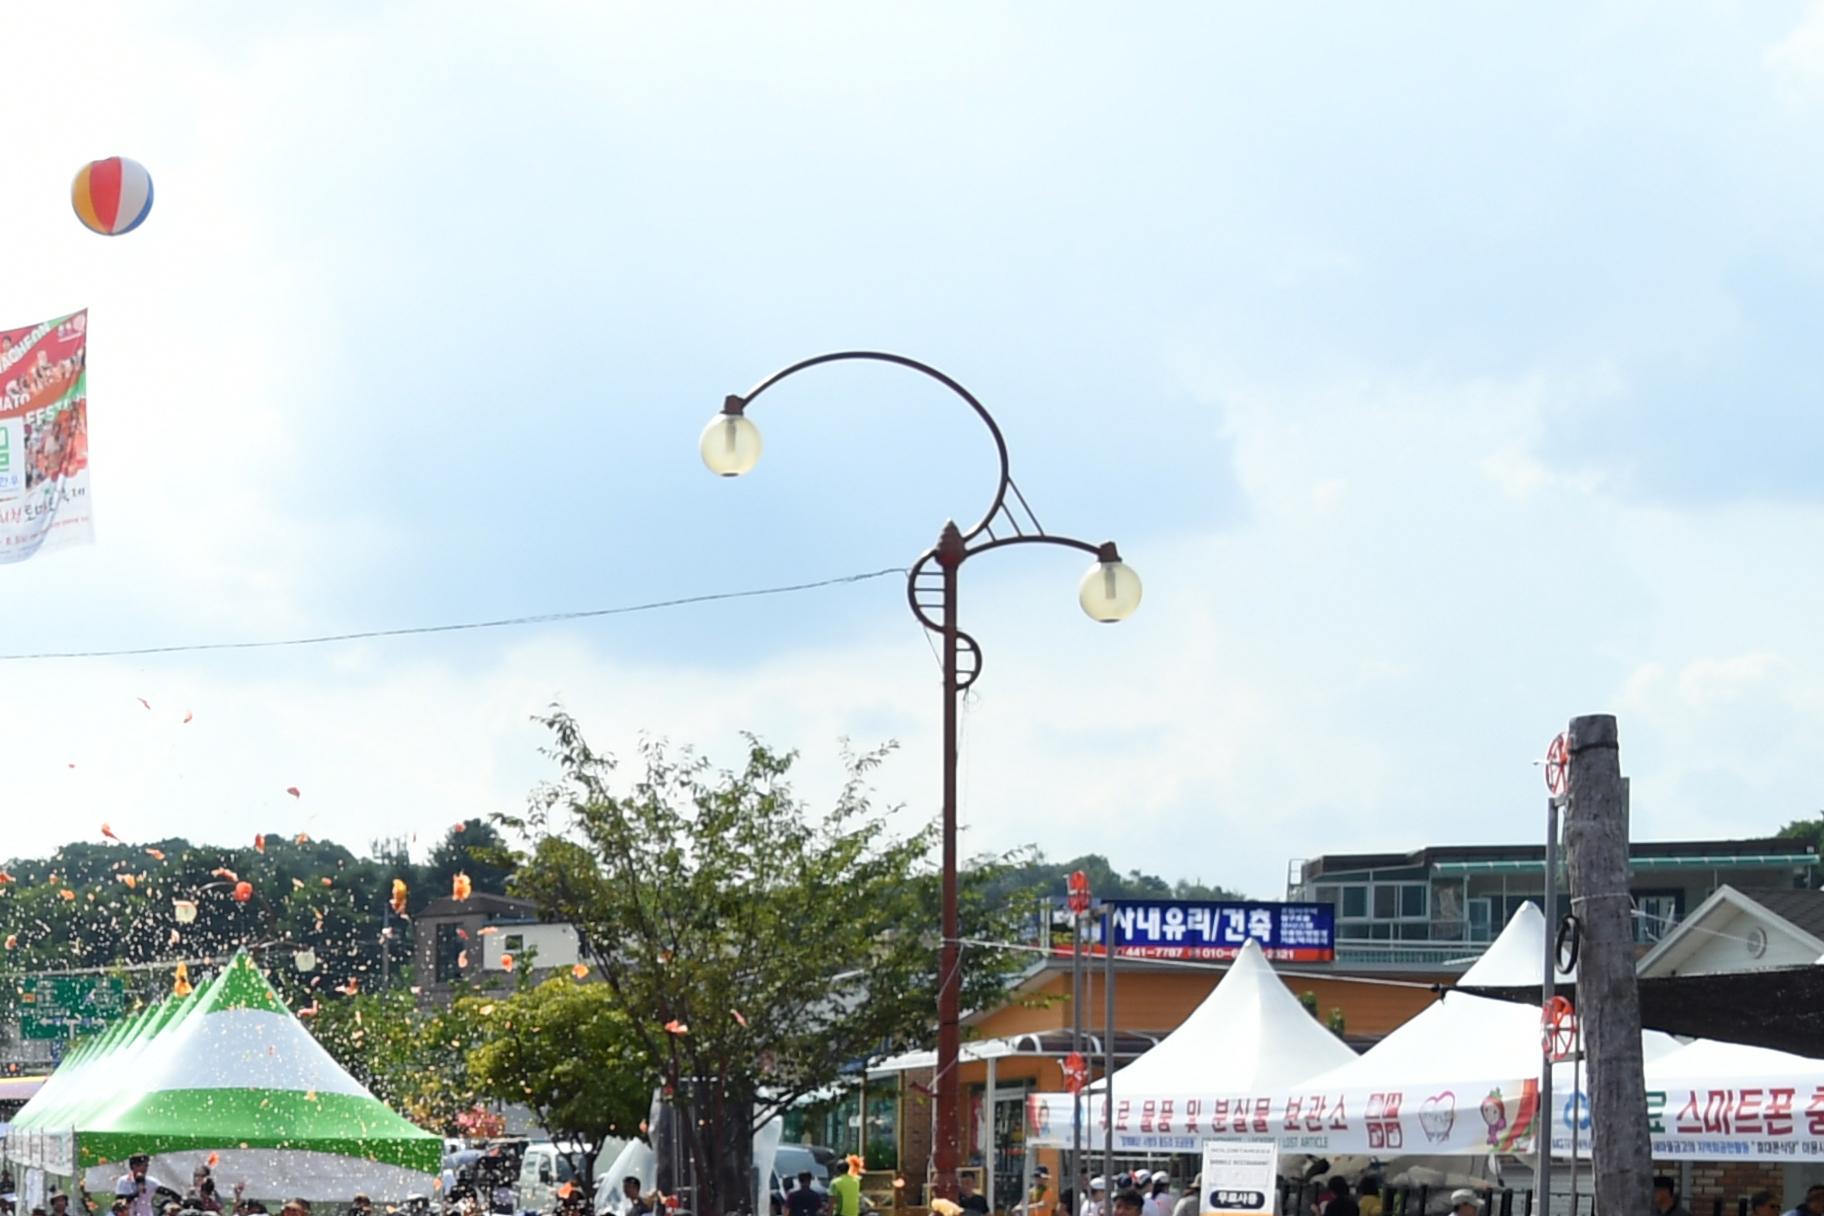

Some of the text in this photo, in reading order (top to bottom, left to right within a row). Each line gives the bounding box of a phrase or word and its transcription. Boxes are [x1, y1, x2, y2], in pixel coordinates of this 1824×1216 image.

[1140, 1100, 1174, 1133] 물품
[1185, 1100, 1201, 1133] 및
[1212, 1097, 1271, 1133] 분실물
[1283, 1093, 1348, 1132] 보관소
[1677, 1088, 1796, 1136] 스마트폰
